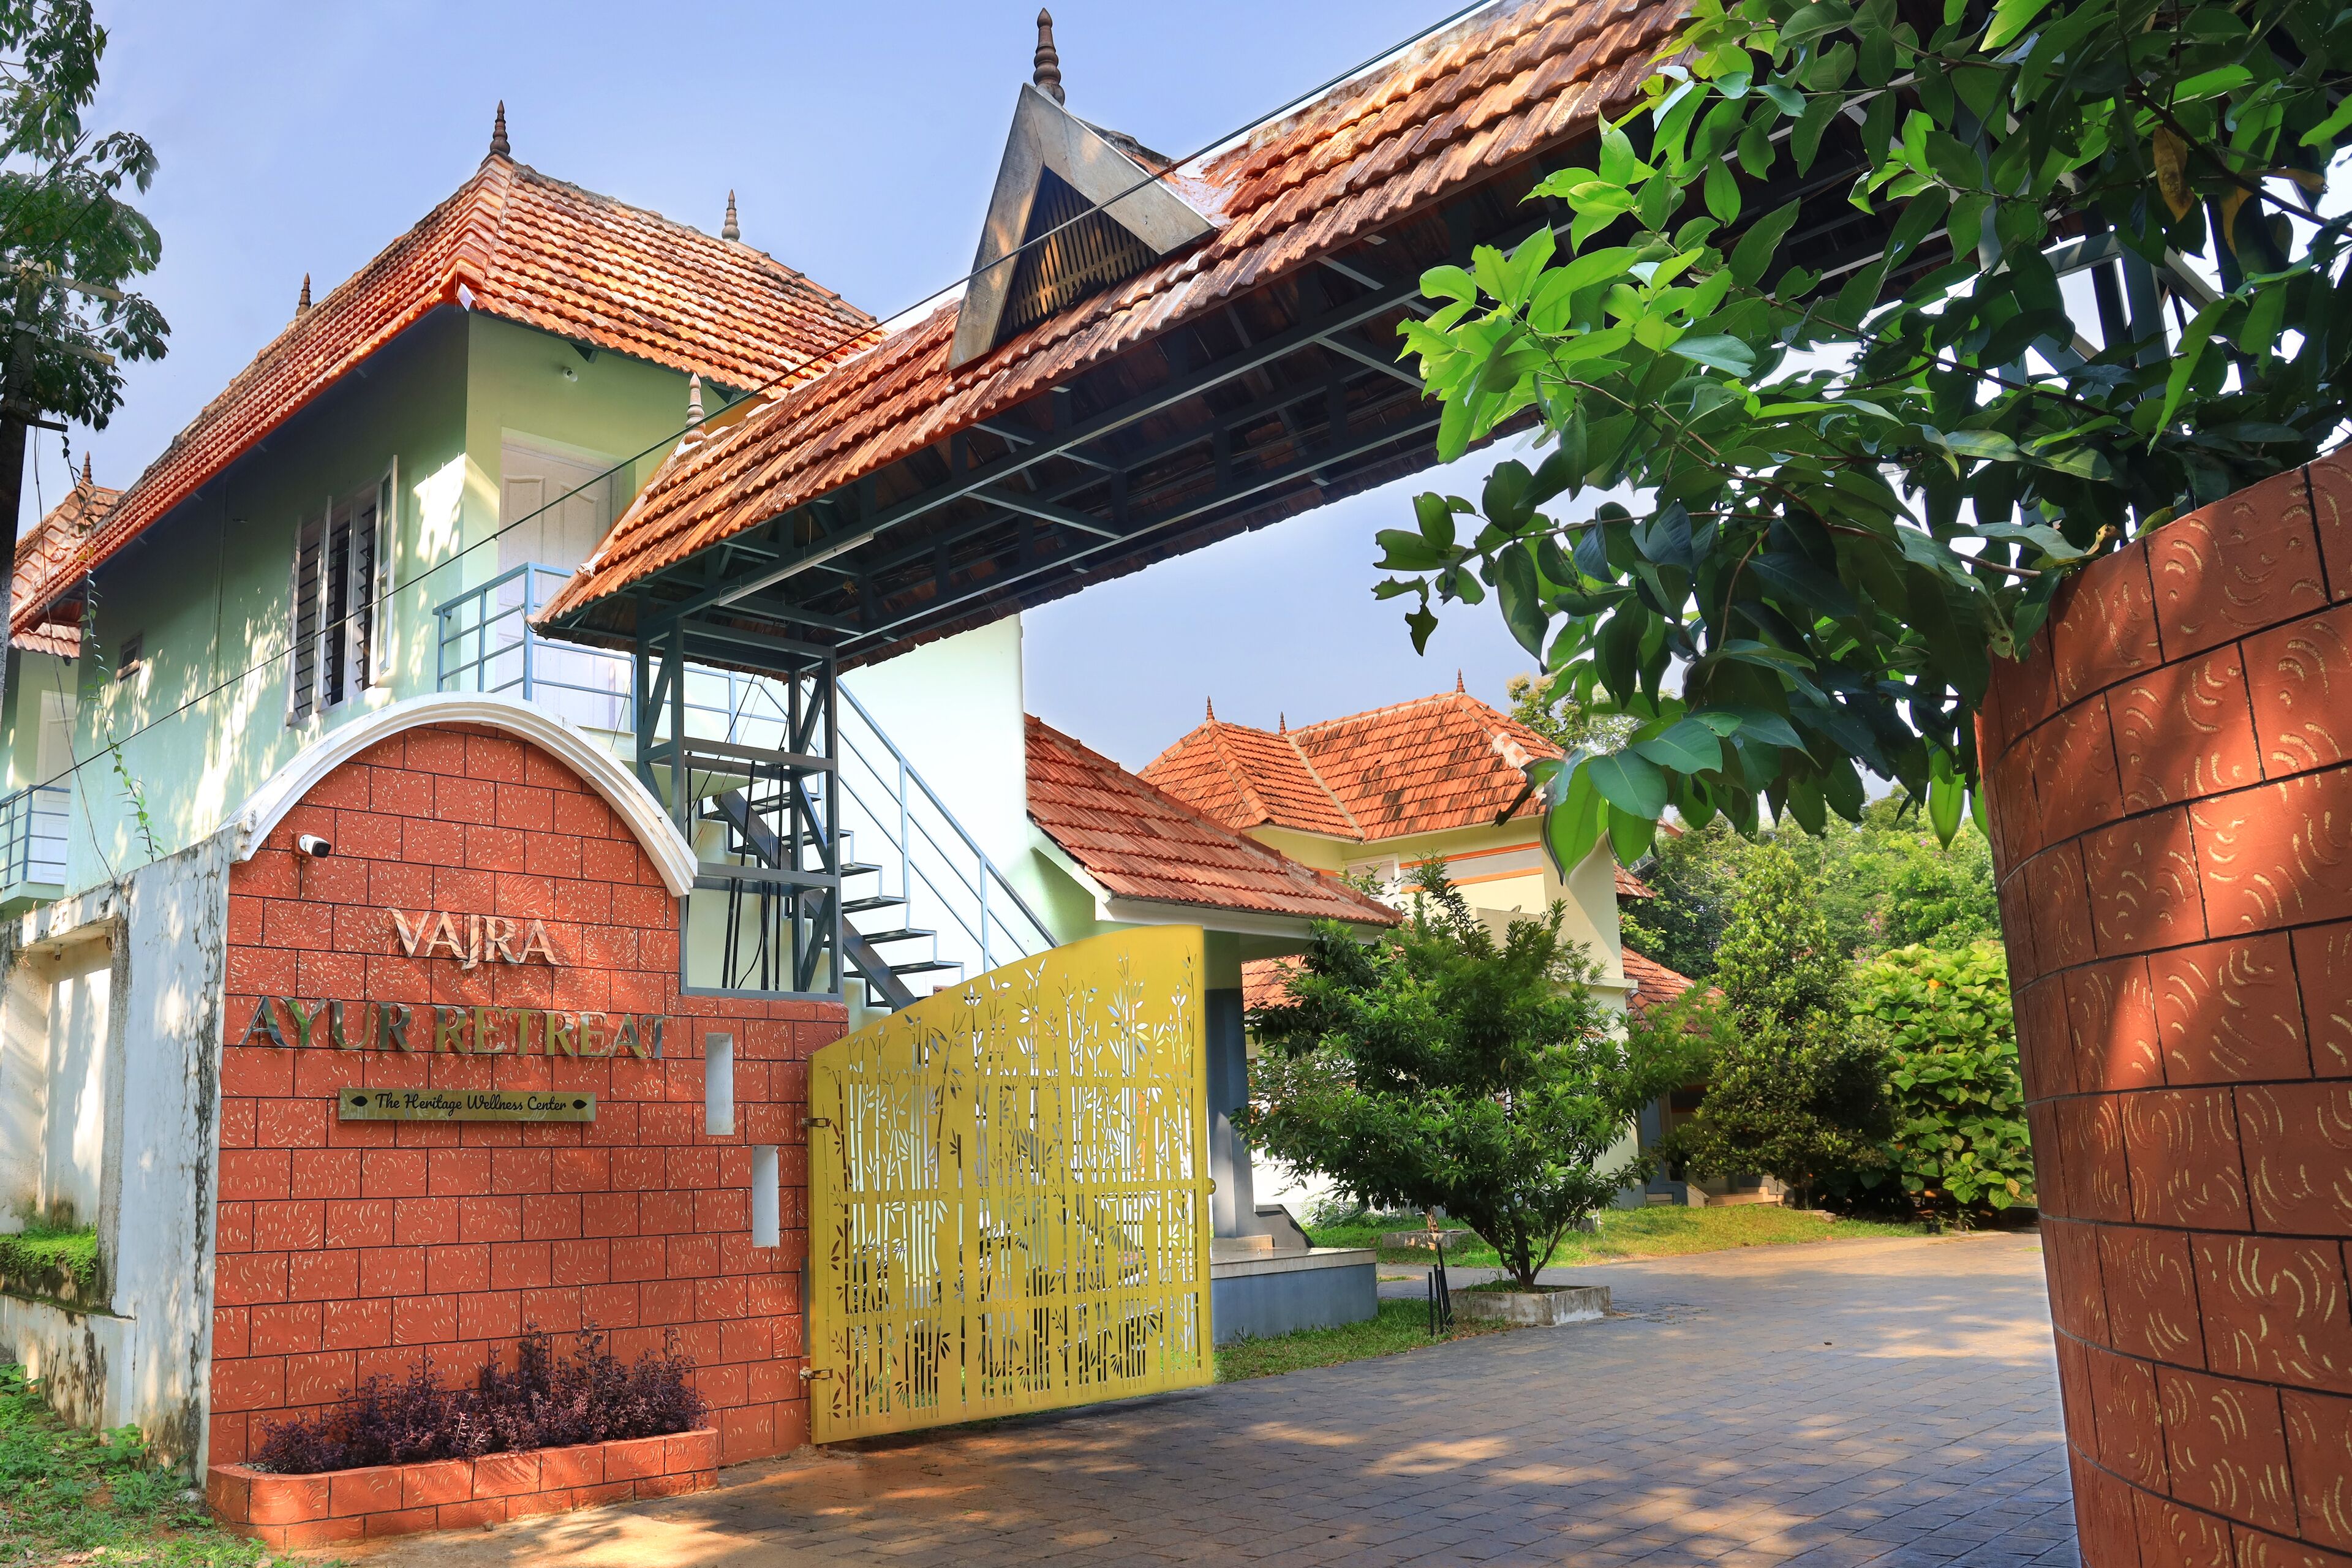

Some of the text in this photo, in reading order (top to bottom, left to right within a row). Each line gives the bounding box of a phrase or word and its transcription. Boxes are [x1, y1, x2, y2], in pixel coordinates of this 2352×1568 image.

[388, 908, 560, 970] VAJRA
[238, 995, 673, 1060] AYUR RETREAT
[375, 1093, 567, 1117] The Heritage Wellness Center
